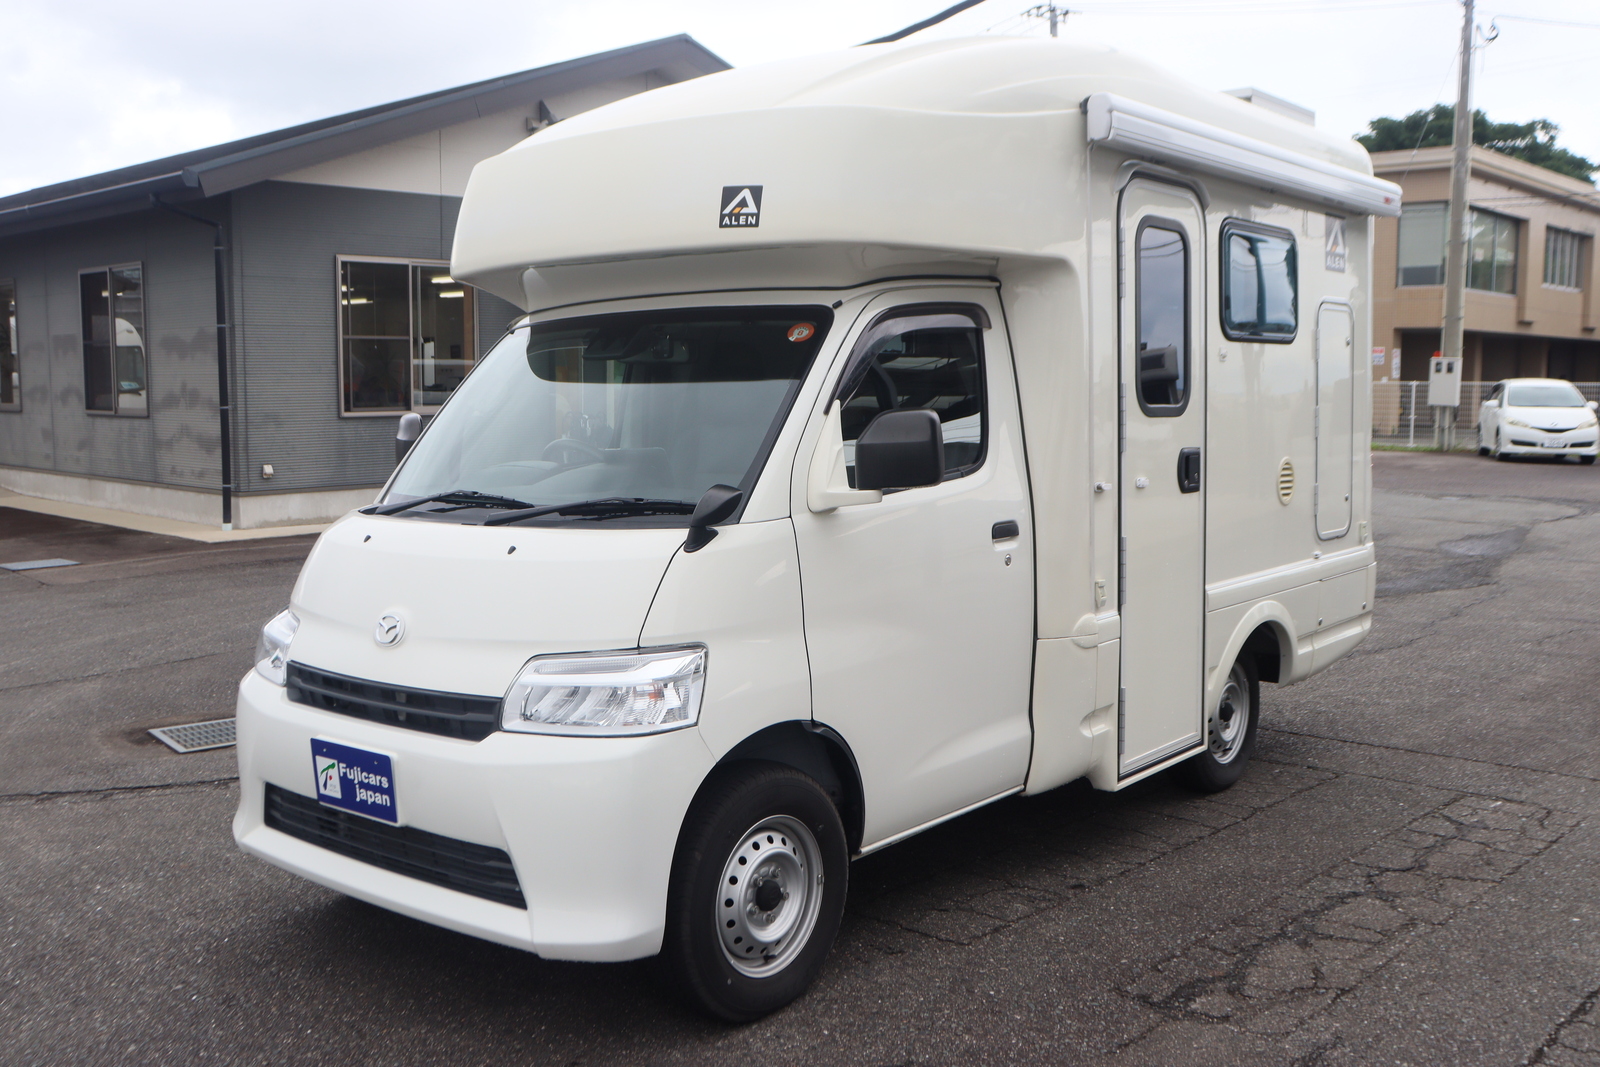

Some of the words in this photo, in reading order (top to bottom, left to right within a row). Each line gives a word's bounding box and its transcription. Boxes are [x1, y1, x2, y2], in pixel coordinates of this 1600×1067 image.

[722, 215, 756, 226] ALEN
[339, 762, 389, 789] Fujicars
[355, 784, 391, 807] japan
